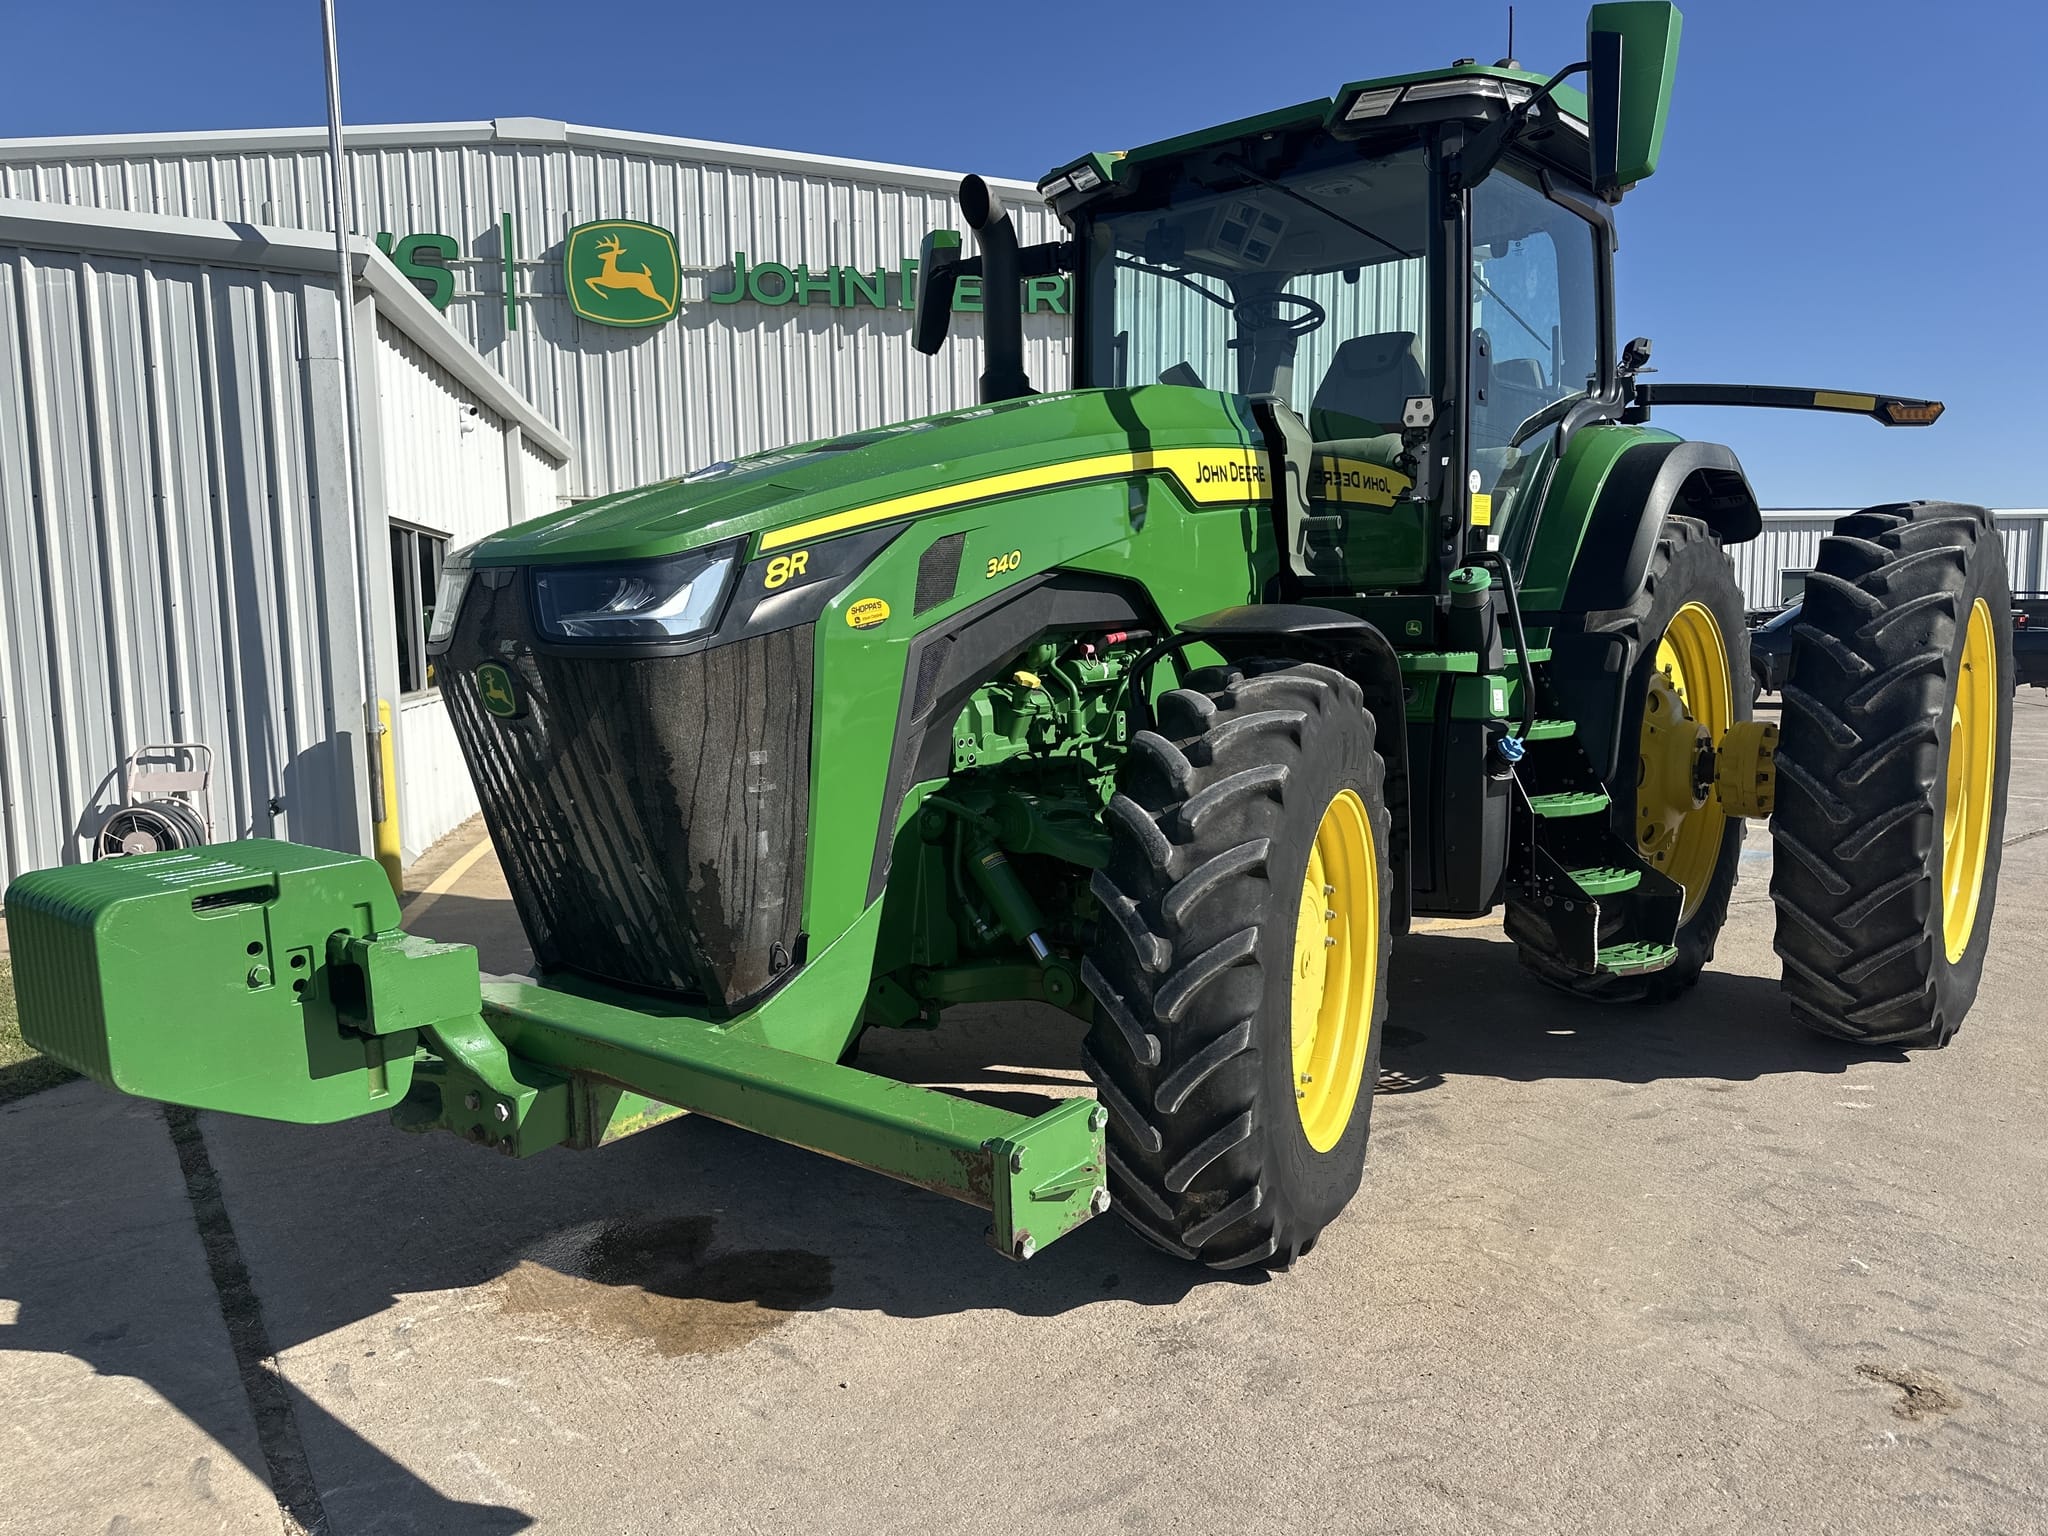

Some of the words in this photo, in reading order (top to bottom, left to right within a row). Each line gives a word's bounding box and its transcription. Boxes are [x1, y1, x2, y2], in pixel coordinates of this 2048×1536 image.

[711, 251, 886, 309] JOHN
[1196, 461, 1228, 483] JOHN
[1229, 461, 1266, 482] DEERE
[764, 550, 809, 589] 8R
[986, 549, 1022, 579] 340
[851, 601, 882, 615] SHOPPA'S
